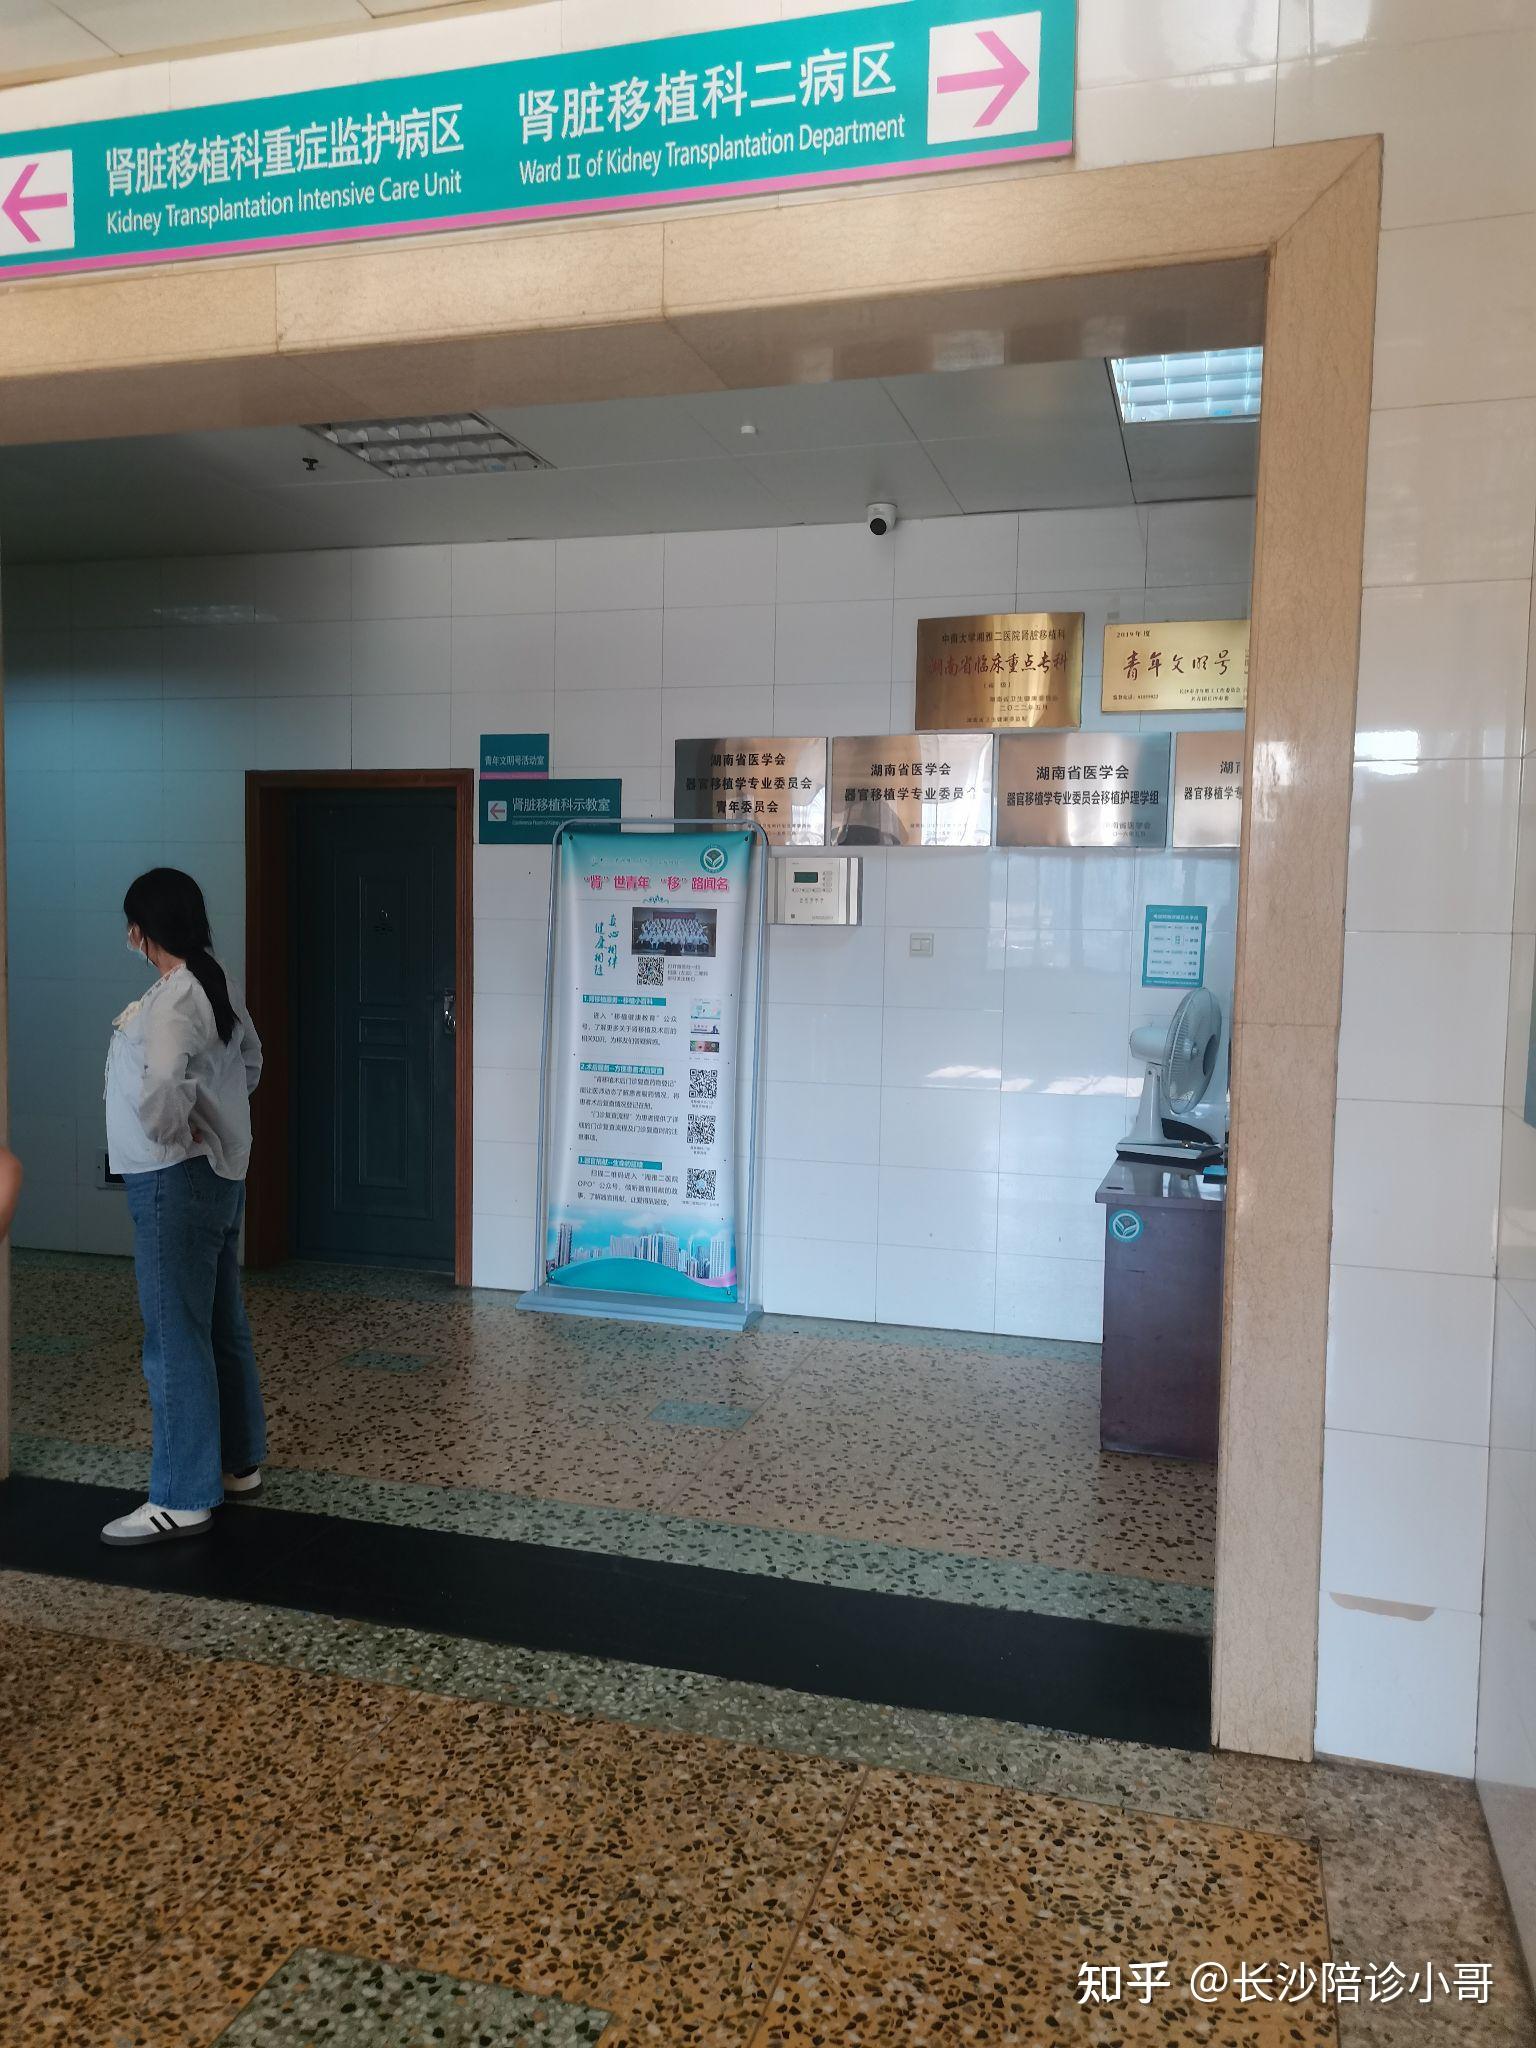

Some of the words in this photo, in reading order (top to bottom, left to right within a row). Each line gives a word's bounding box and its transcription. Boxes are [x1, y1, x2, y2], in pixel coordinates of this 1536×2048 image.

[519, 45, 897, 144] 肾脏移植科二病区
[107, 105, 464, 196] 肾脏移植科重症监护病区
[520, 156, 560, 184] Ward
[587, 150, 603, 176] of
[607, 147, 661, 176] Kidney
[666, 129, 794, 169] Transplantation
[800, 114, 906, 155] Department
[107, 209, 161, 235] Kidney
[166, 192, 293, 229] Transplantation
[299, 182, 375, 212] Intensive
[379, 177, 419, 201] Care
[425, 170, 462, 196] Unit
[930, 651, 1068, 677] 湖南省临床重点专科
[1123, 650, 1231, 681] 青年文明号
[485, 755, 545, 767] 青年文明号活动室
[711, 753, 786, 766] 湖南省医学会
[871, 763, 951, 776] 湖南省医学会
[1036, 764, 1130, 781] 湖南省医学会
[686, 777, 812, 790] 器官移植学专业委员会
[512, 797, 611, 812] 肾脏移植科示教室
[1006, 789, 1160, 807] 器官移植学专业委员会移植护理学组
[716, 800, 779, 814] 青年委员会
